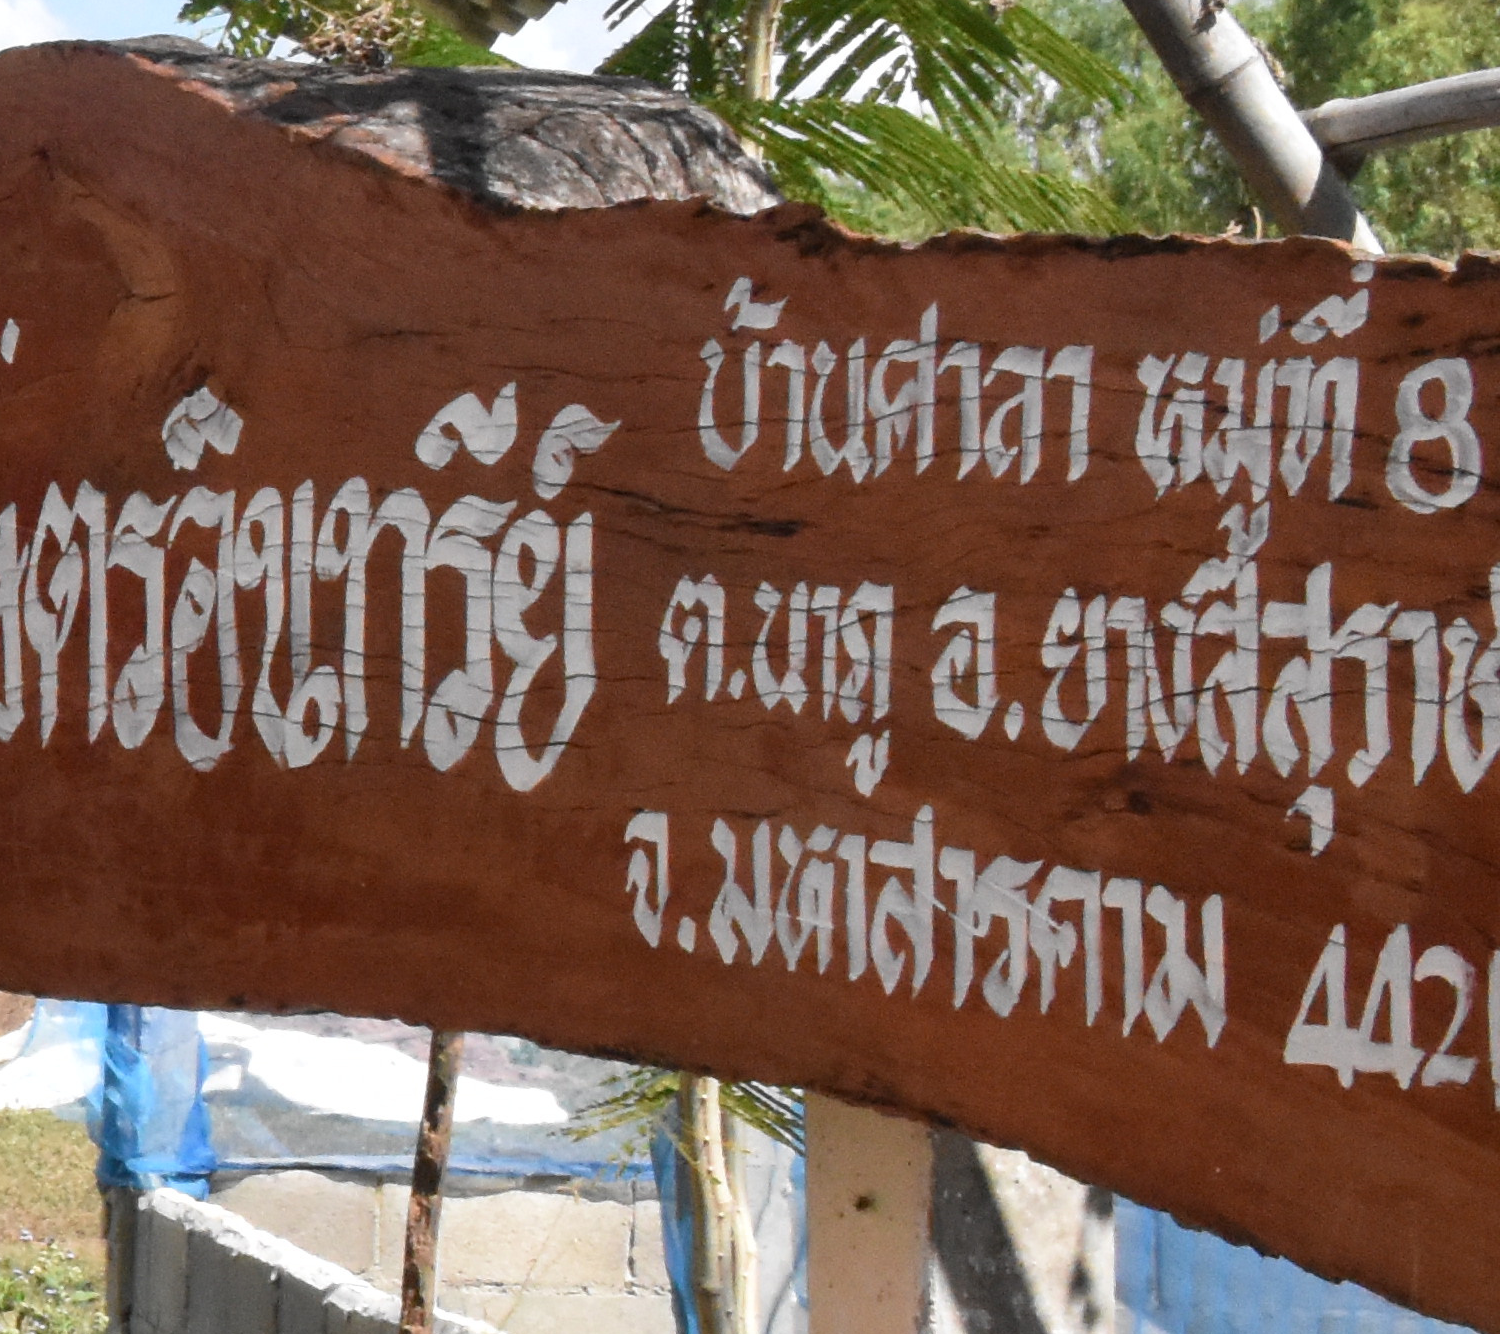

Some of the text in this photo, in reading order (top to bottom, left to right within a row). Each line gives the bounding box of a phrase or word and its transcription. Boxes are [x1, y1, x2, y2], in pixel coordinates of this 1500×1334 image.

[697, 259, 1483, 557] บ้านศาลา หมู่ที่ 8
[624, 804, 1228, 1049] จ.มหาสารคาม
